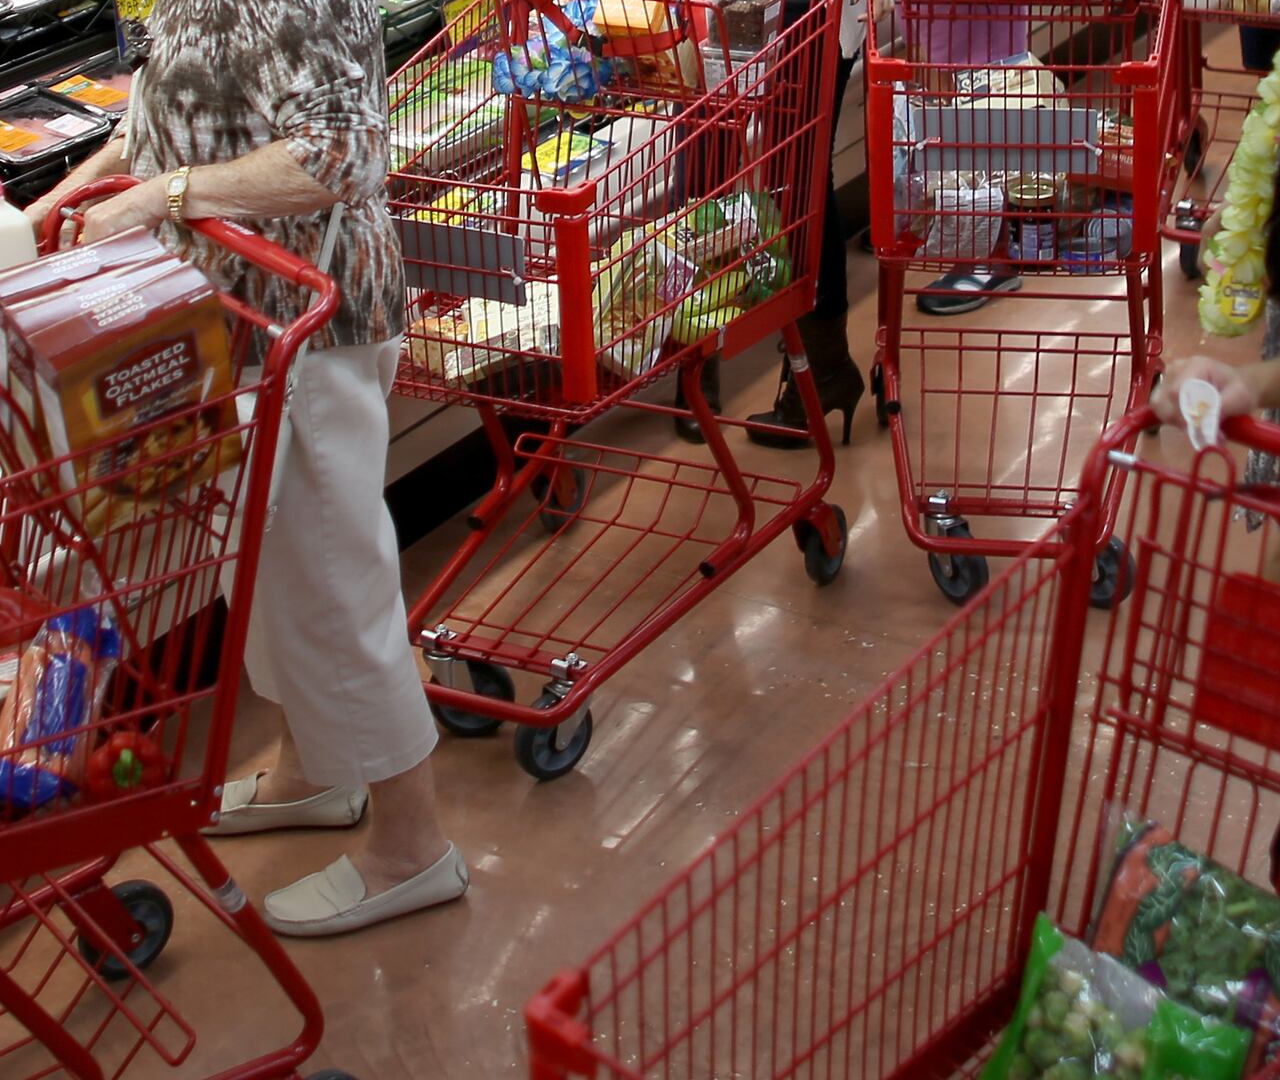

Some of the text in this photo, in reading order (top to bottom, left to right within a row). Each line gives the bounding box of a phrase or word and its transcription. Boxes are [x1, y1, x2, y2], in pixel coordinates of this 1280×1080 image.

[104, 341, 186, 387] TOASTED
[105, 355, 192, 400] OATMEAL
[116, 368, 184, 408] FLAKES
